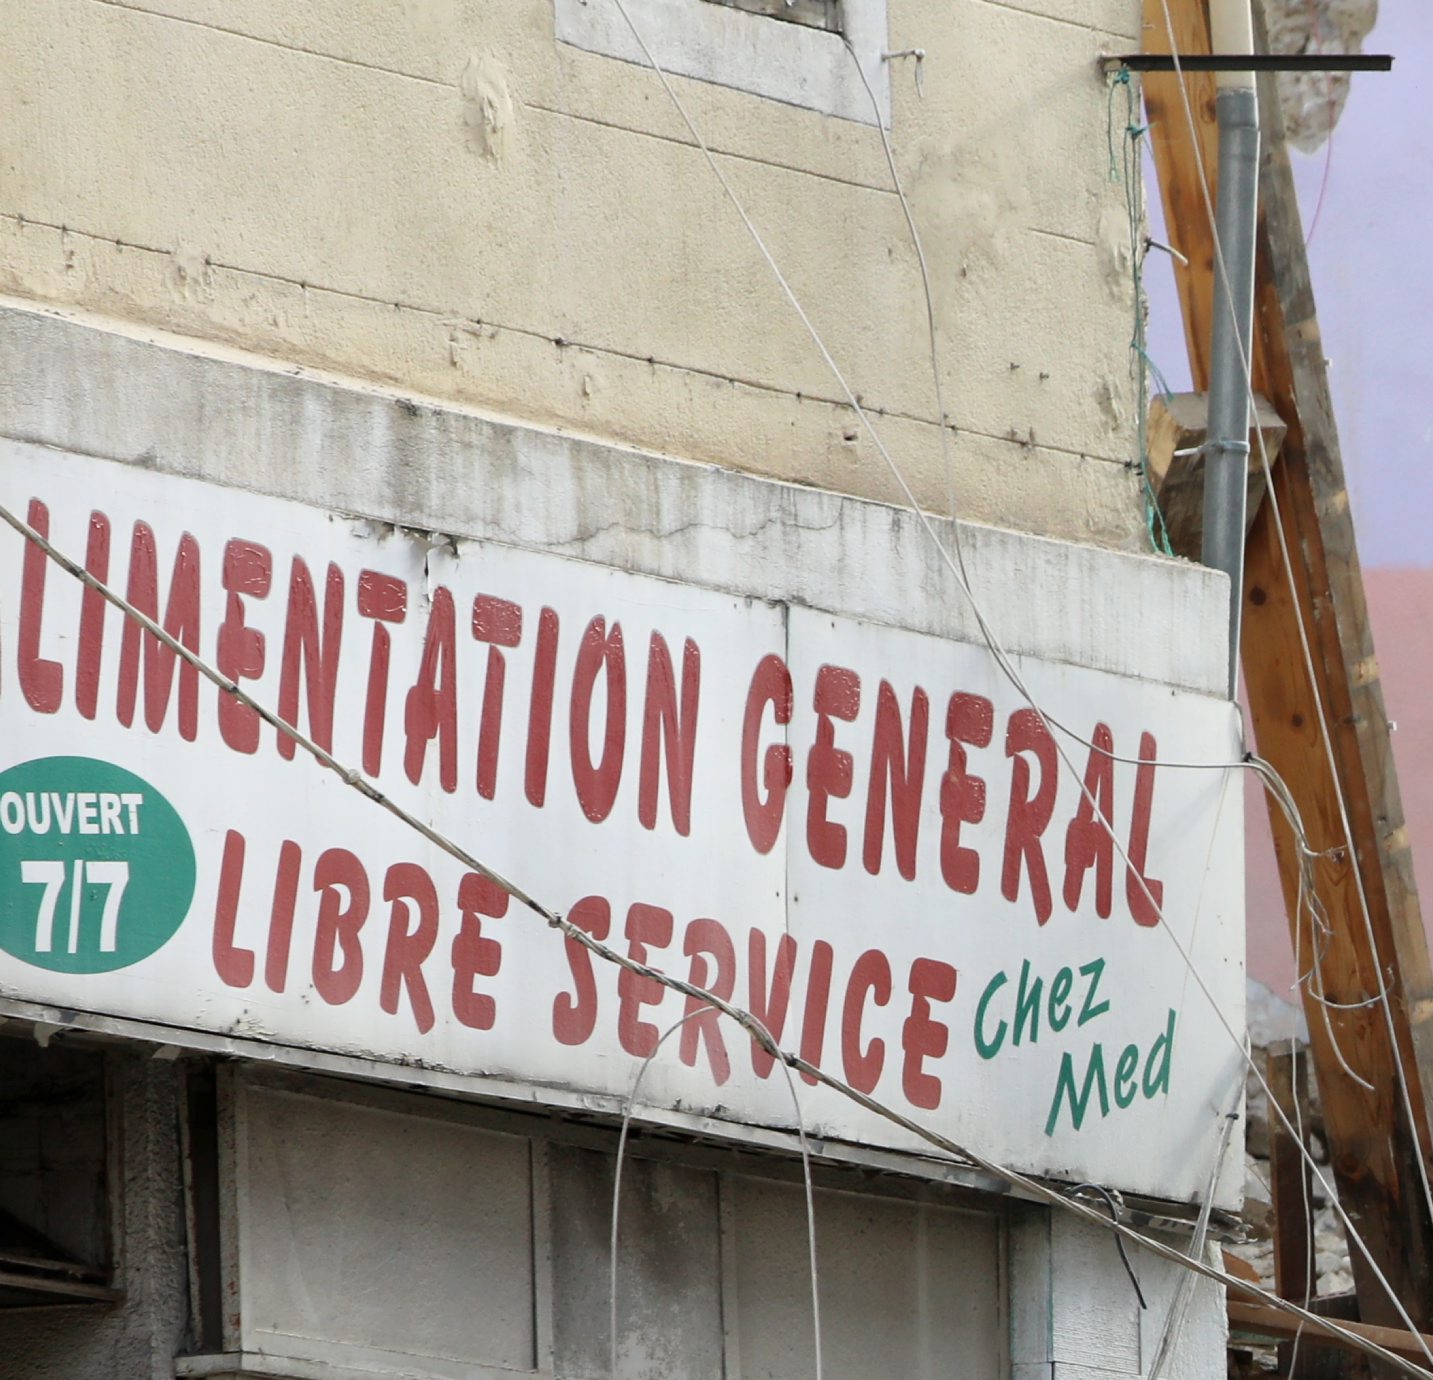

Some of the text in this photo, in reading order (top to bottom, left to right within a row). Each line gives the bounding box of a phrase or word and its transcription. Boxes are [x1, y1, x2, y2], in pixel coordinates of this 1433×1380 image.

[2, 792, 143, 834] OUVERT
[741, 653, 1164, 928] GENERAL
[21, 860, 129, 953] 7/7
[212, 829, 957, 1110] LIBRE SERVICE
[974, 957, 1110, 1060] Chez
[1044, 1007, 1176, 1137] Med
